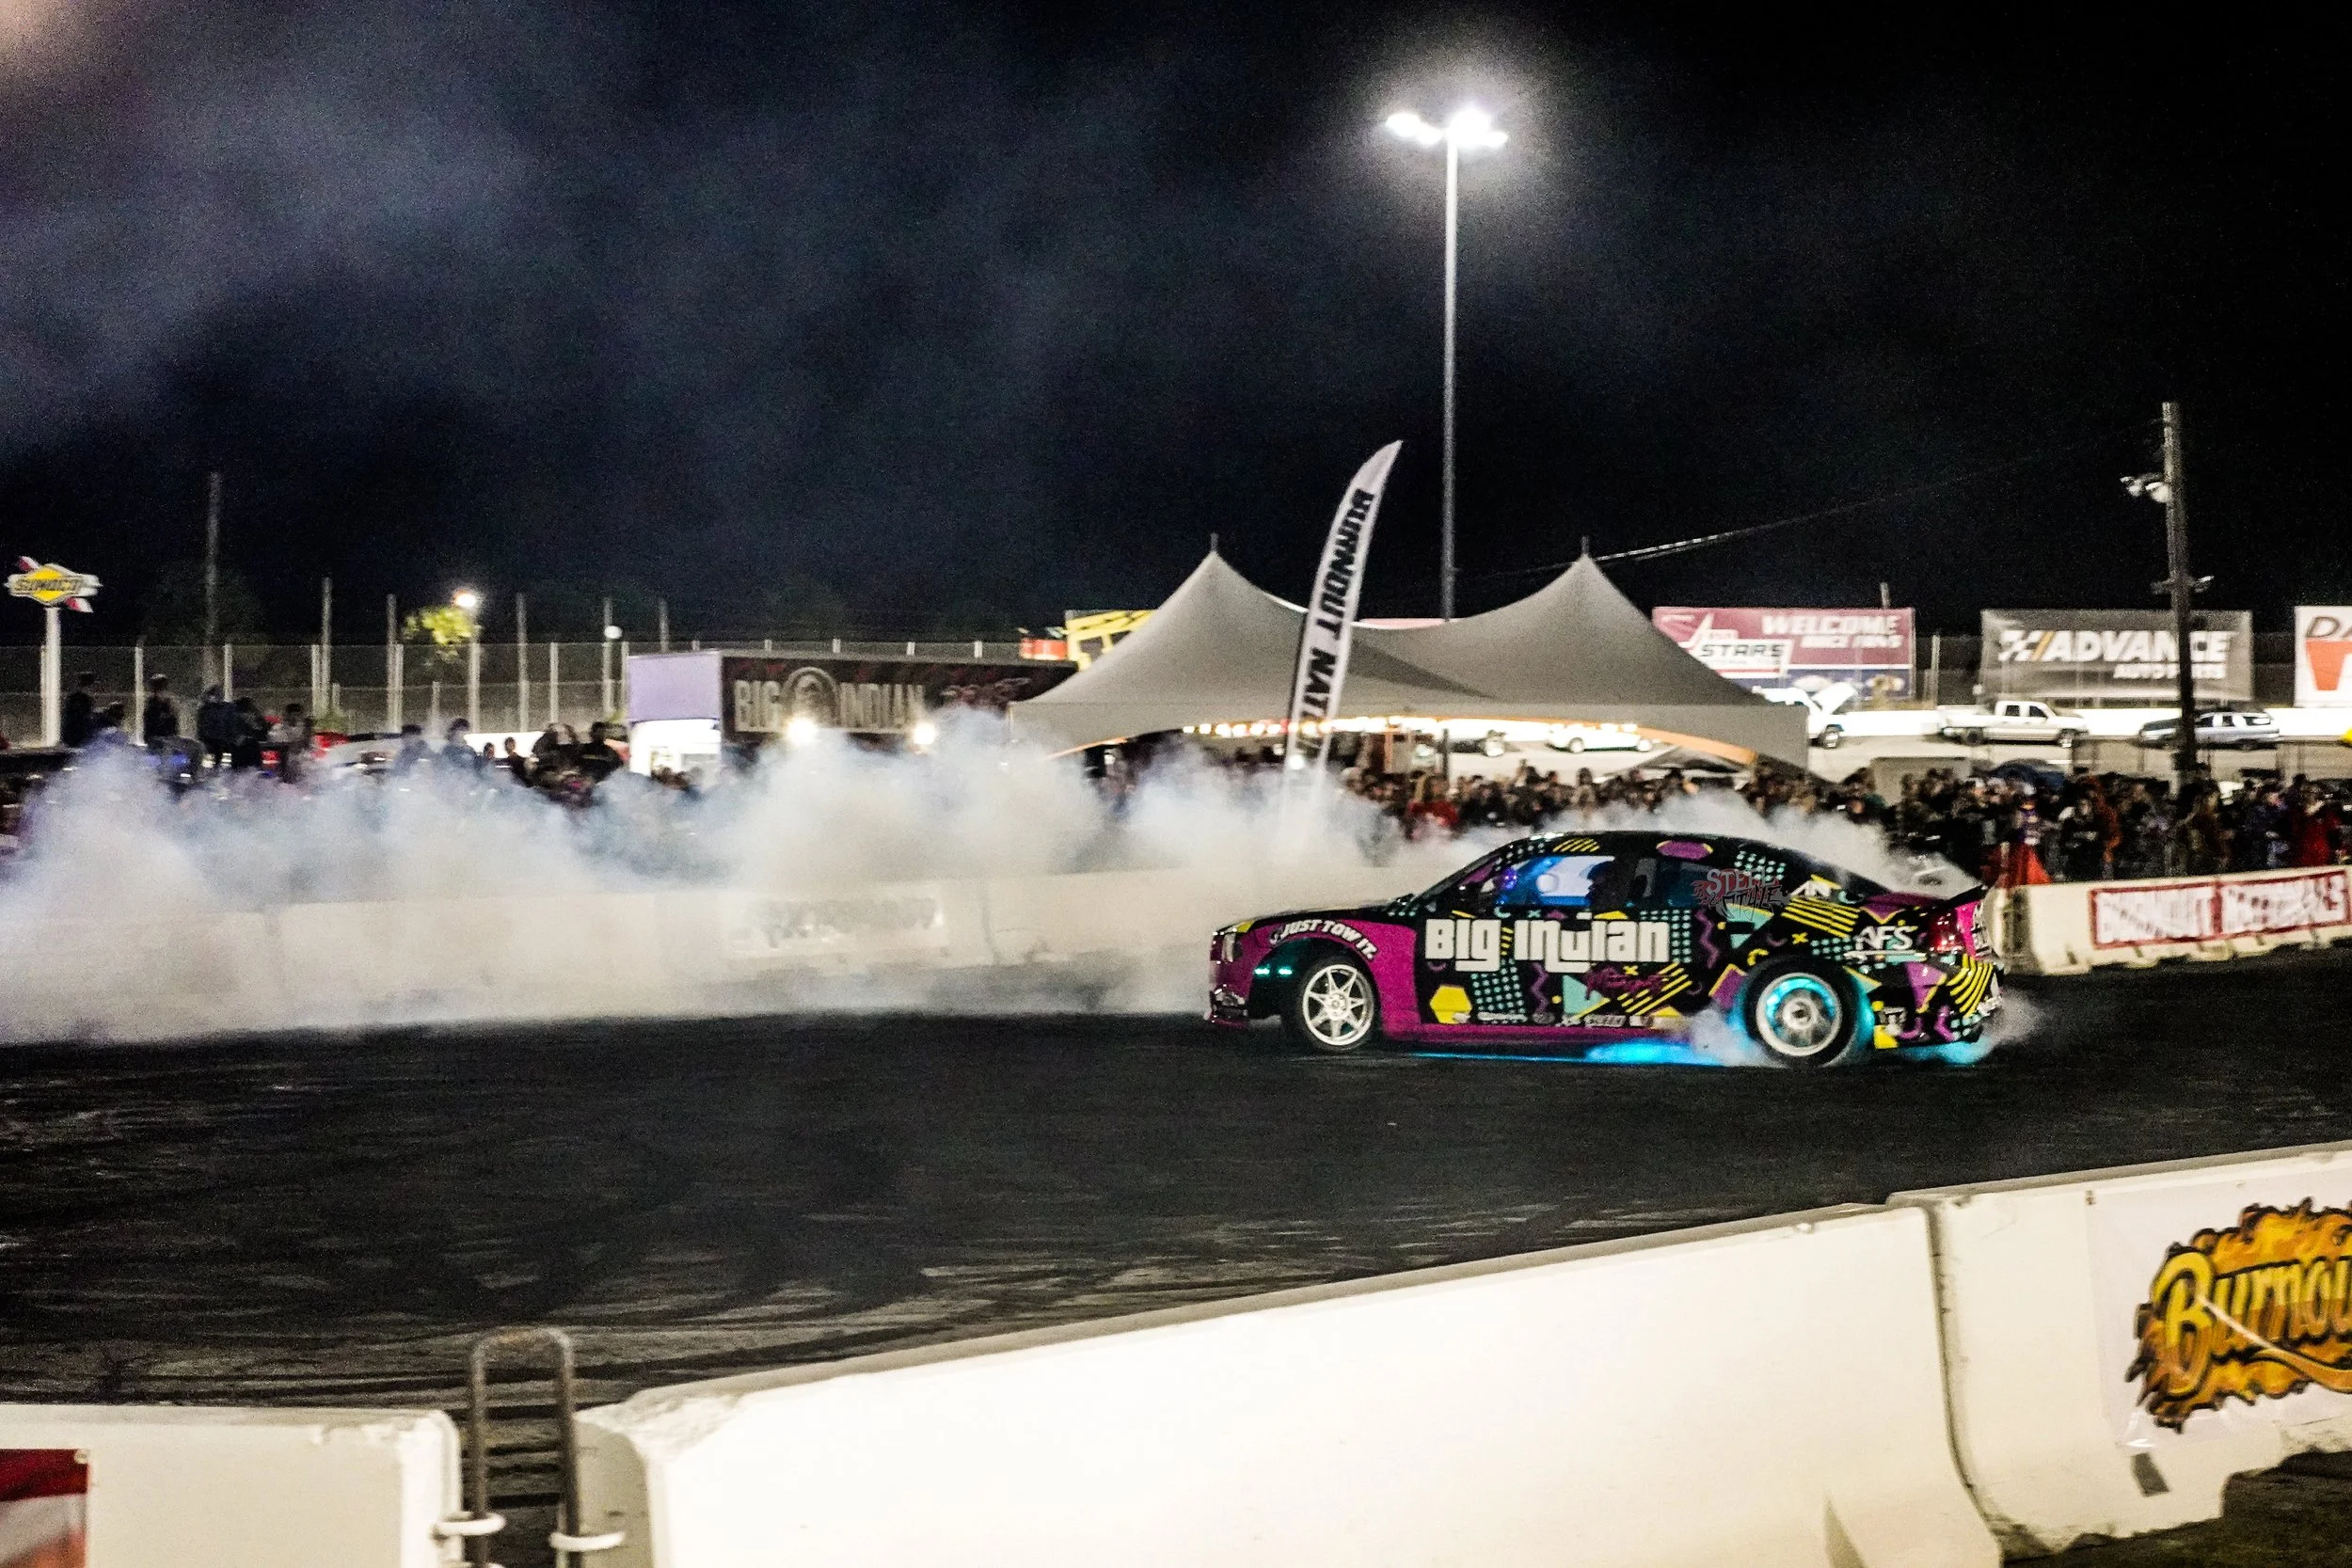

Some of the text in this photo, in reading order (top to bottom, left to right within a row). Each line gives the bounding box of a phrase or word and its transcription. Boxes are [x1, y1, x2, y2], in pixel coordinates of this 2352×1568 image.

[1761, 615, 1901, 635] WELCOME
[1699, 642, 1788, 657] STARS
[734, 679, 782, 733] BIG
[1279, 919, 1323, 941] JUST
[1321, 920, 1362, 942] TOW
